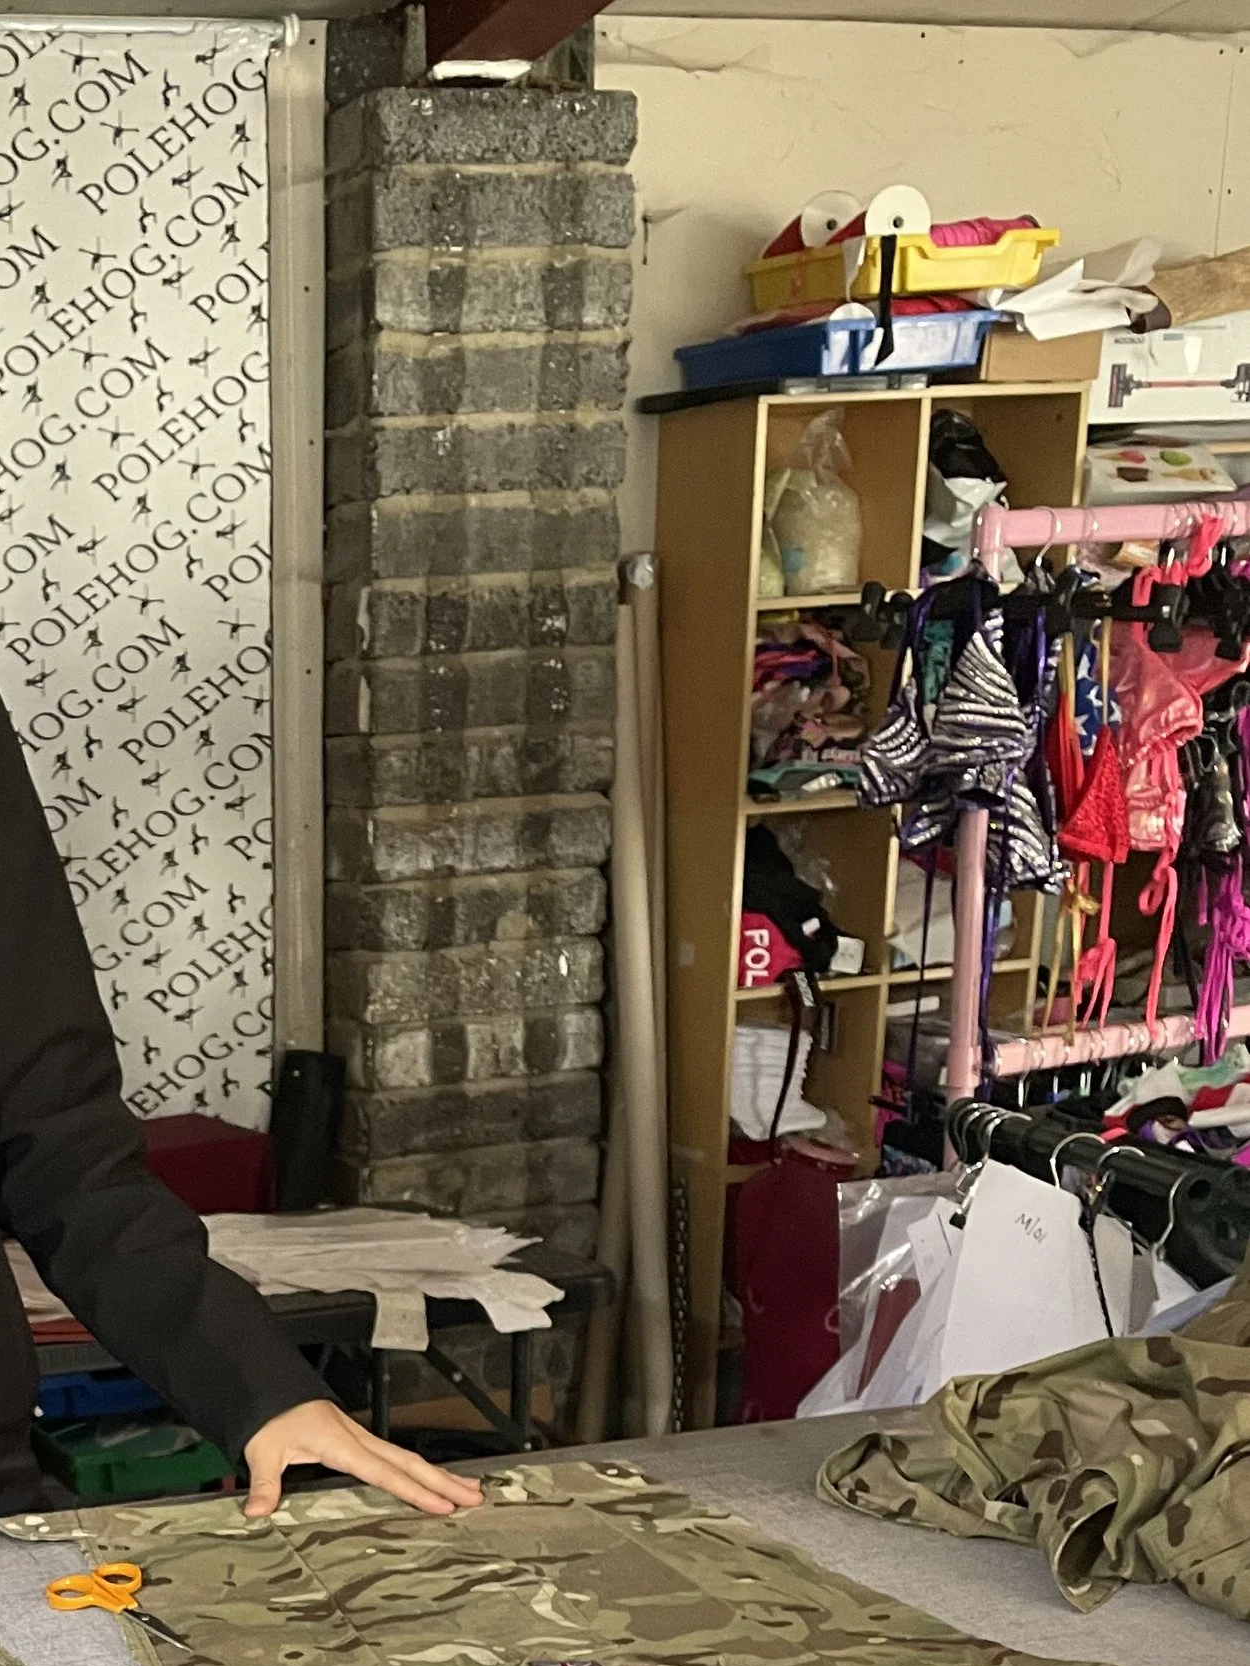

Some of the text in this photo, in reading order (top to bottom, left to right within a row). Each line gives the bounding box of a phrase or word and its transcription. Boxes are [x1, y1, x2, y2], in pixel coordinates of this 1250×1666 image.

[77, 58, 267, 216] POLEHOG
[6, 443, 271, 665] POLEHOG.COM
[743, 929, 770, 988] POL
